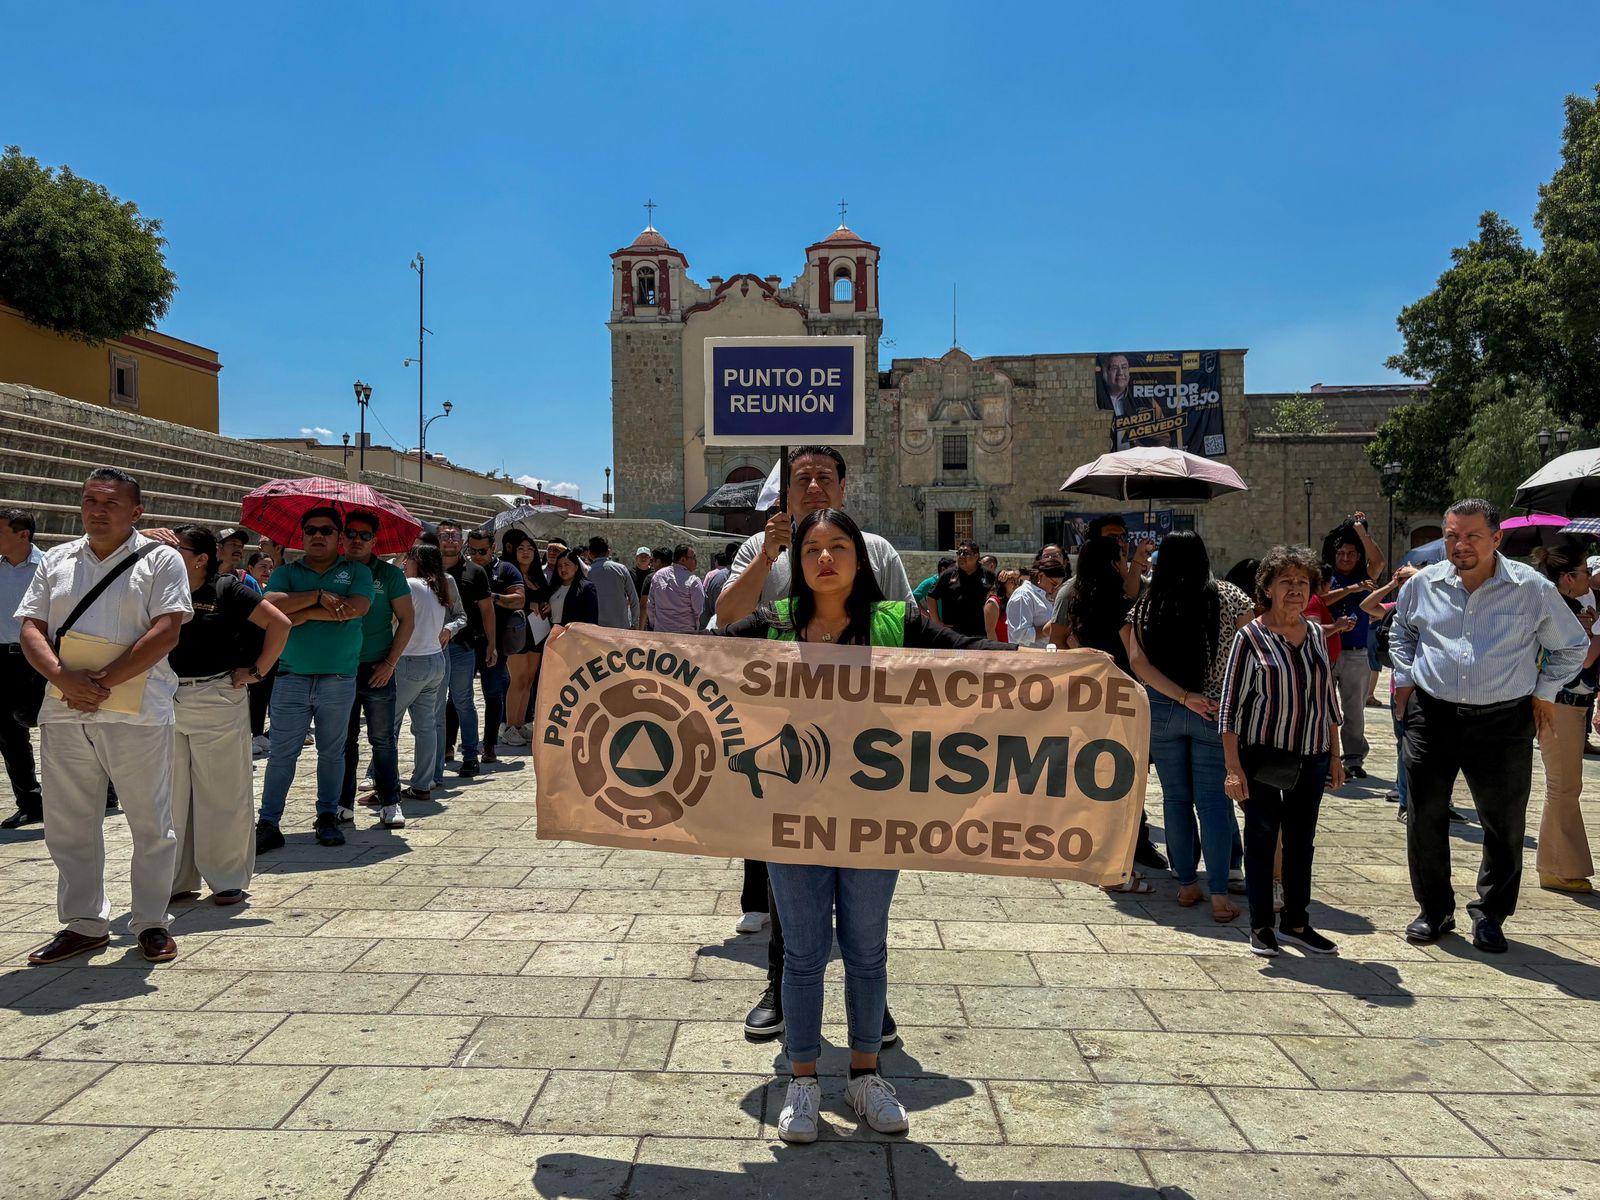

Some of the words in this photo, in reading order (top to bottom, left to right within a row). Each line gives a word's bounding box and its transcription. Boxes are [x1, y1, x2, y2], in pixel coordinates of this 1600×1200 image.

[724, 368, 803, 387] PUNTO
[810, 368, 841, 387] DE
[730, 389, 834, 413] REUNIÓN
[1133, 383, 1200, 398] RECTOR
[1166, 390, 1220, 409] UABJO
[1116, 412, 1151, 428] FARID
[1129, 418, 1183, 438] ACEVEDO
[739, 660, 1055, 712] SIMULACRO
[1067, 674, 1137, 717] DE
[544, 648, 700, 747] PROTECCION
[697, 679, 745, 756] CIVIL
[850, 728, 1136, 801] SISMO
[772, 812, 837, 851] EN
[849, 817, 1093, 862] PROCESO
